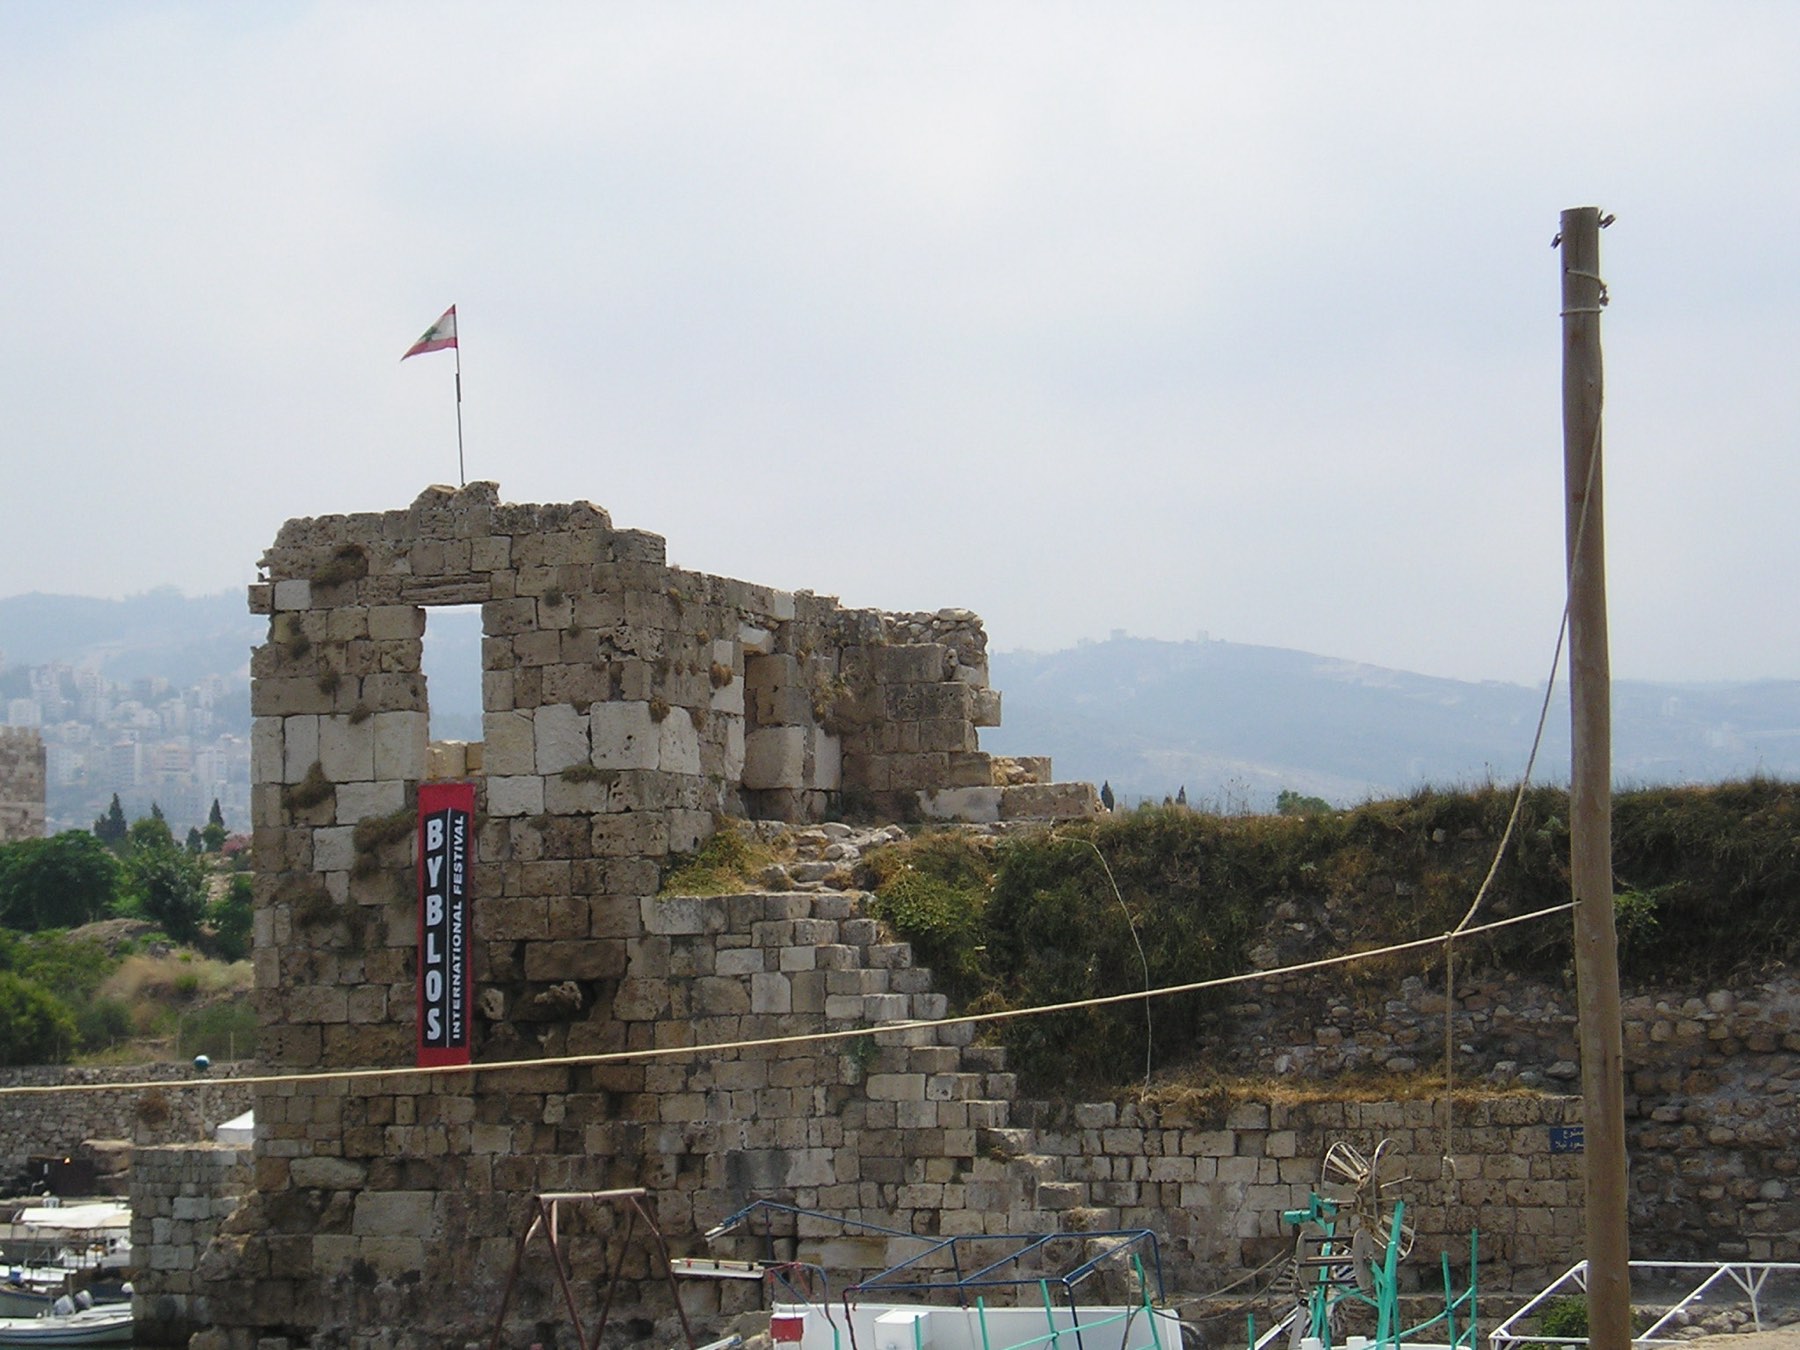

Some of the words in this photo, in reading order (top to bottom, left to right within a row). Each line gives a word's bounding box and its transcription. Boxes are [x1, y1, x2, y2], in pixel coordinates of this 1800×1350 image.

[453, 815, 464, 895] FESTIVAL
[426, 818, 443, 1040] BYBLOS
[452, 900, 463, 1039] INTERNATIONAL
